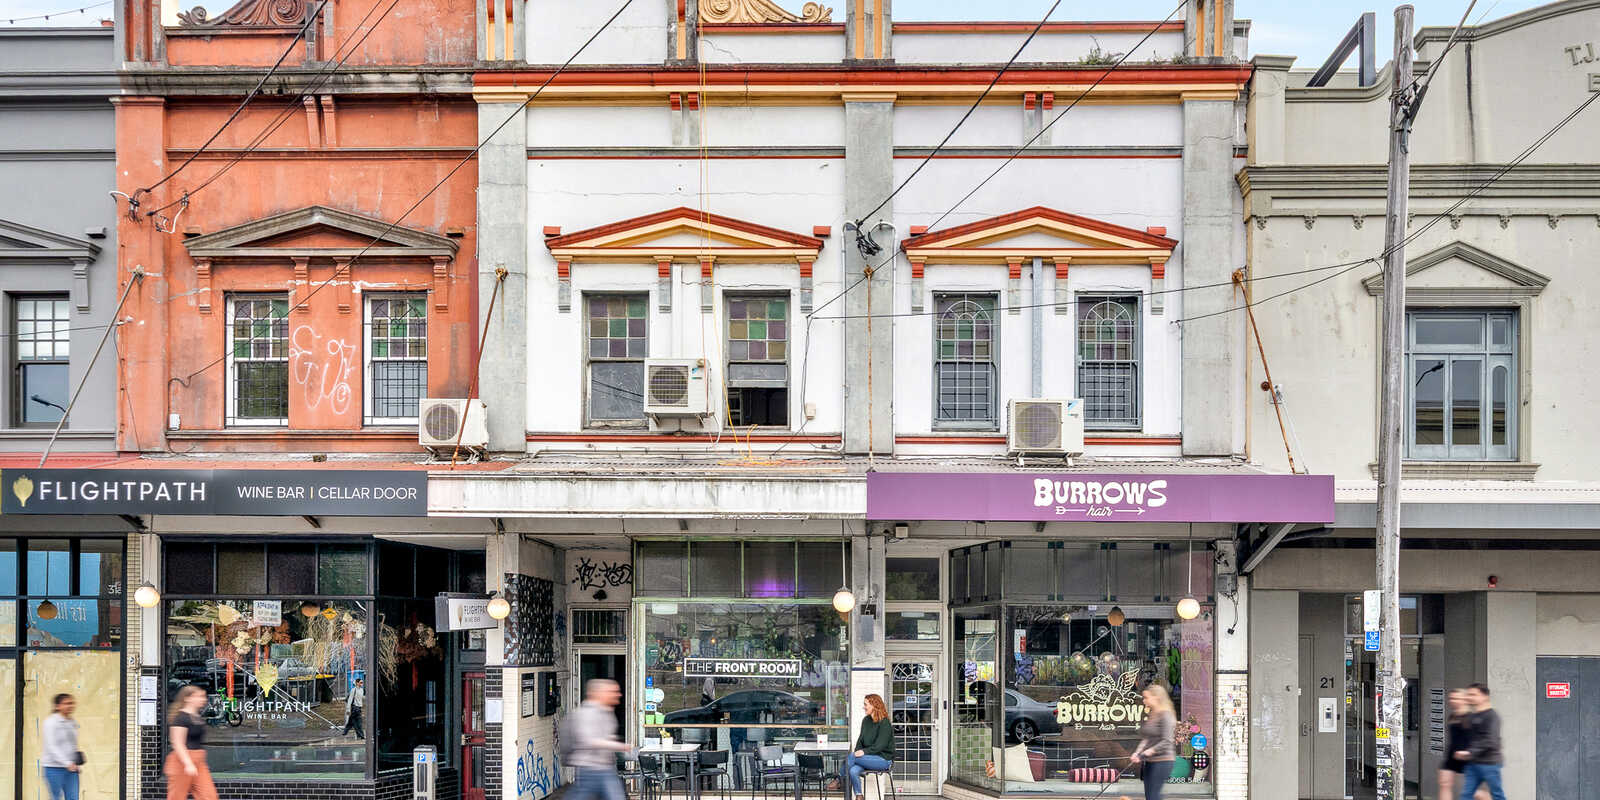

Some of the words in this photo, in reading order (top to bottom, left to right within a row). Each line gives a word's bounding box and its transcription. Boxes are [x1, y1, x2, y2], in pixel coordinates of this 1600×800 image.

[39, 481, 206, 501] FLIGHTPATH
[237, 486, 274, 499] WINE
[277, 486, 305, 499] BAR
[318, 487, 370, 500] CELLAR
[373, 487, 417, 500] DOOR
[1033, 478, 1168, 507] BURROWS
[1086, 505, 1113, 517] hair
[688, 662, 712, 673] THE
[715, 662, 757, 673] FRONT
[759, 663, 797, 674] ROOM
[1320, 676, 1335, 689] 21
[222, 701, 311, 712] FLIGHTPATH
